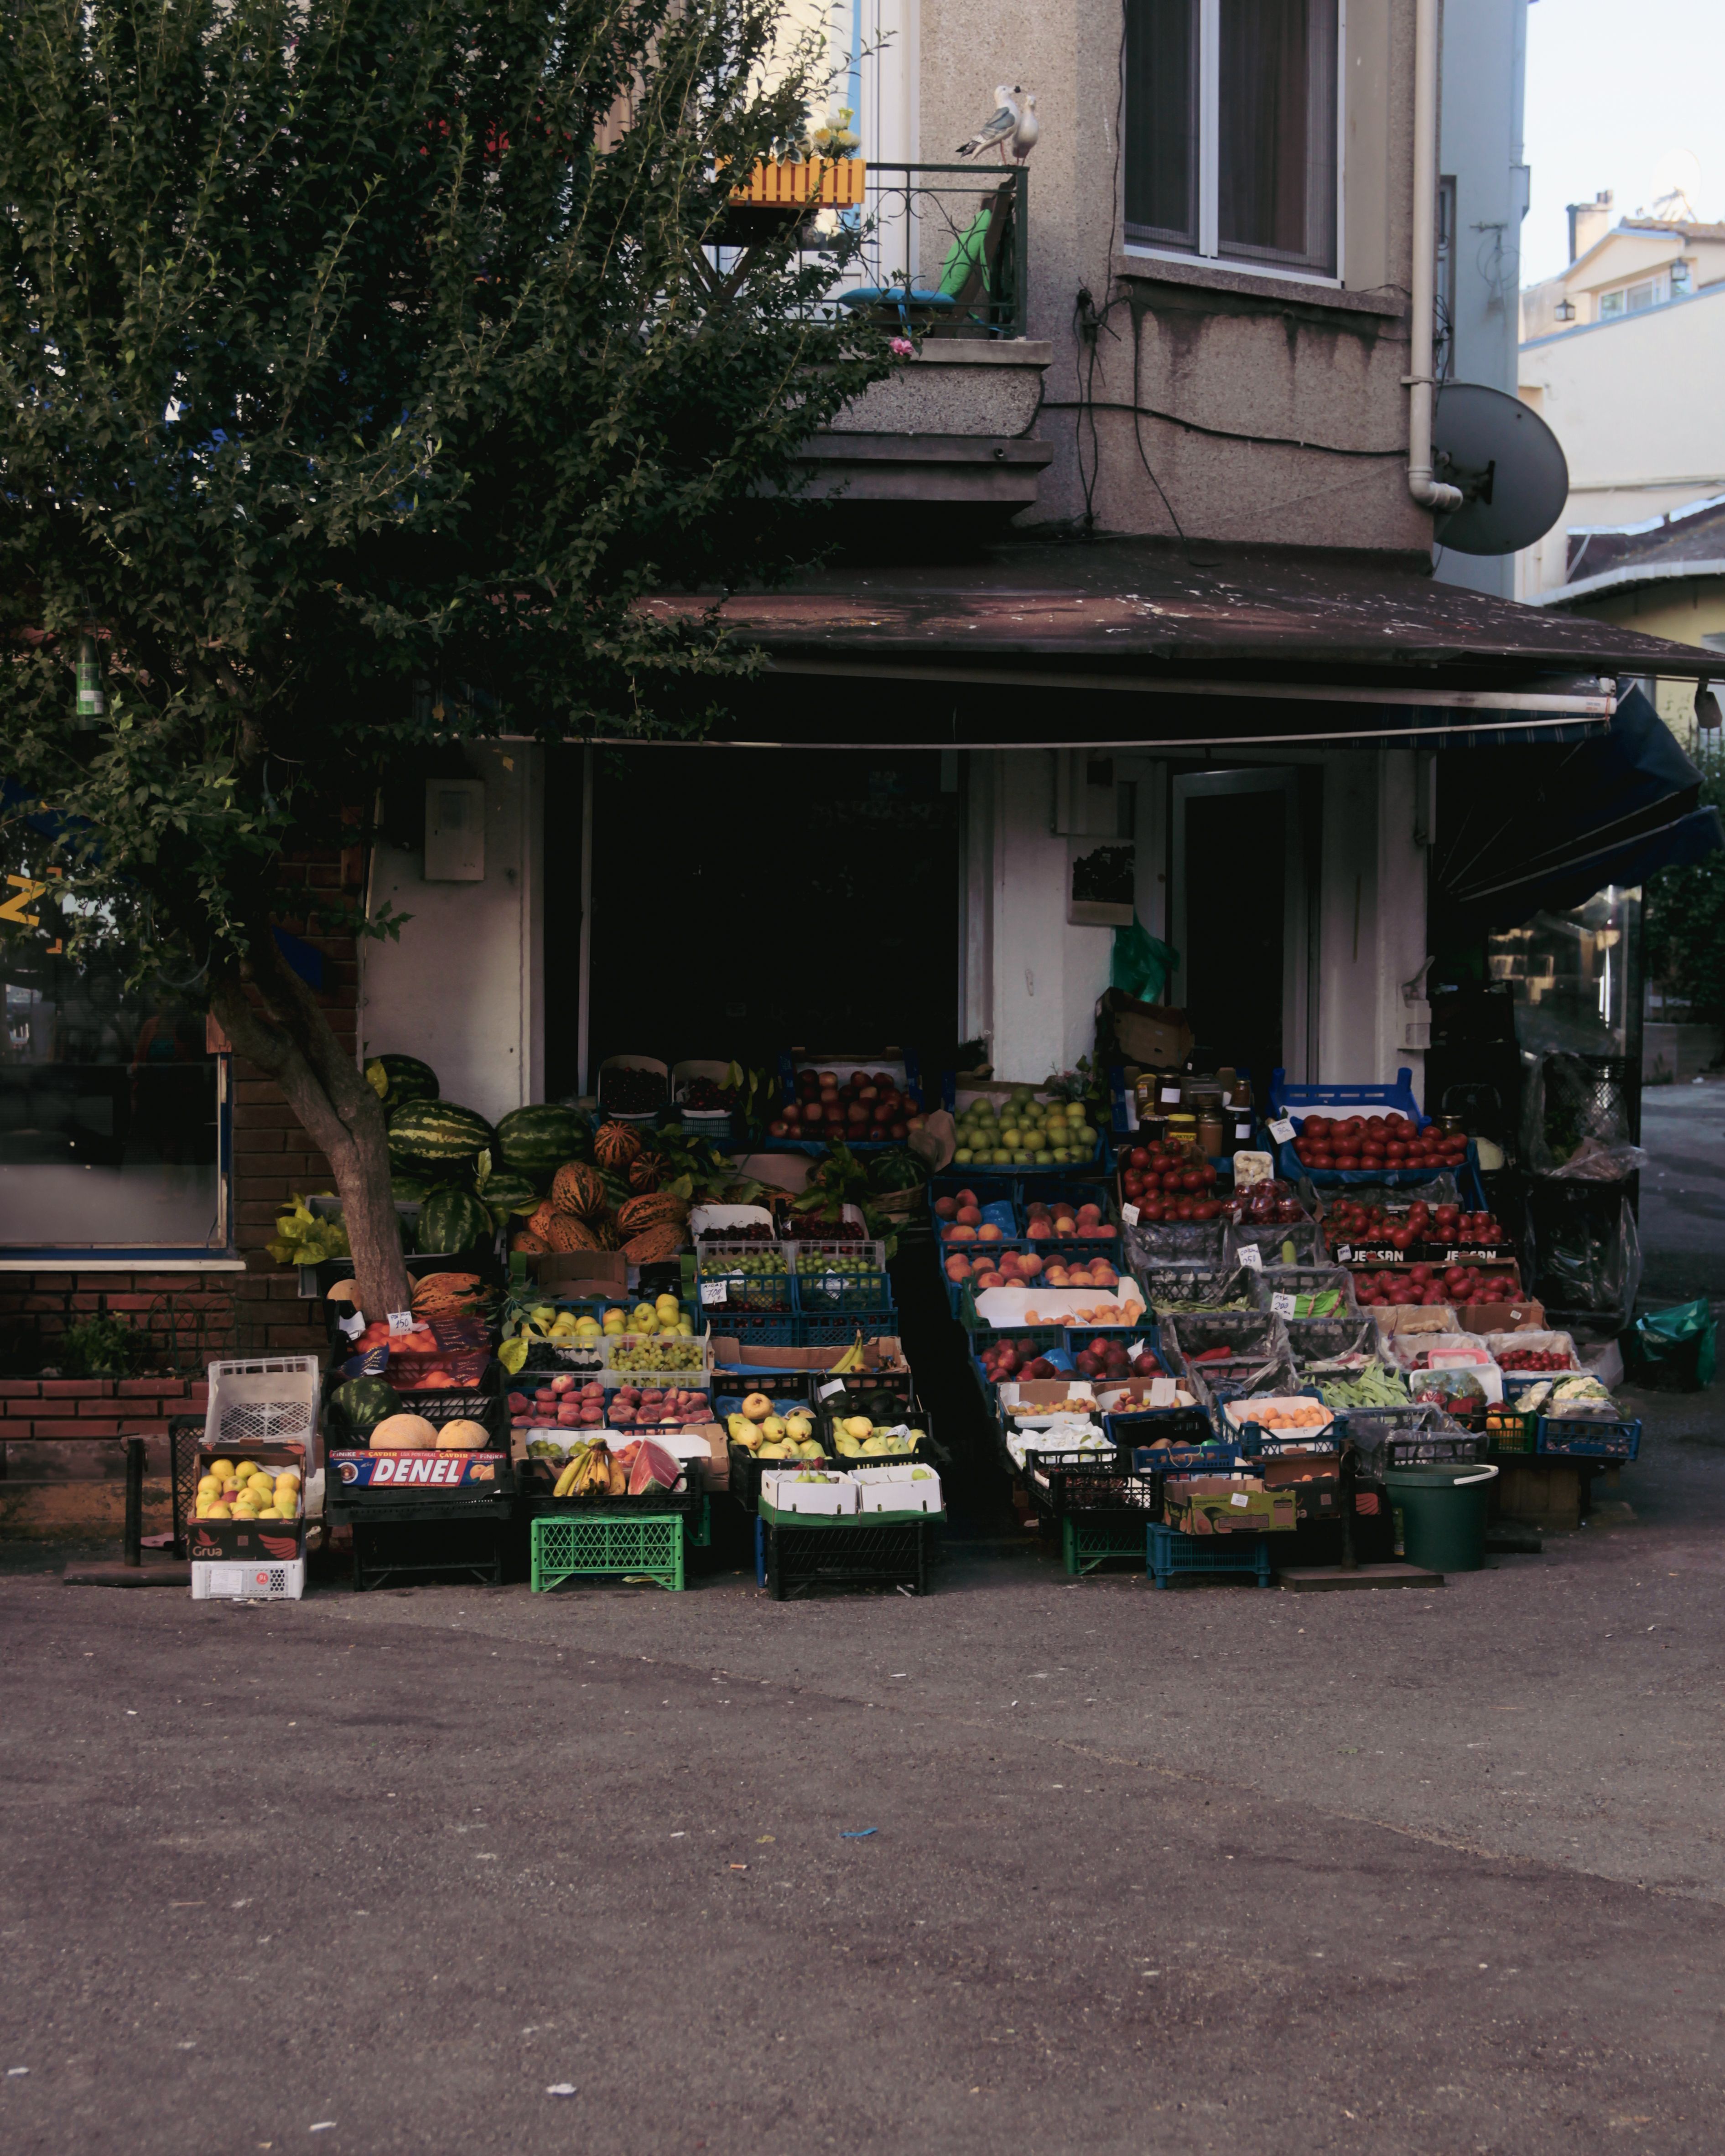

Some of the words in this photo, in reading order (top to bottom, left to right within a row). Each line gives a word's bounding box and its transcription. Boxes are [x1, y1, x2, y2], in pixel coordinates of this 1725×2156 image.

[396, 1318, 409, 1328] 150
[372, 1458, 459, 1483] DENEL
[192, 1545, 223, 1556] Grua
